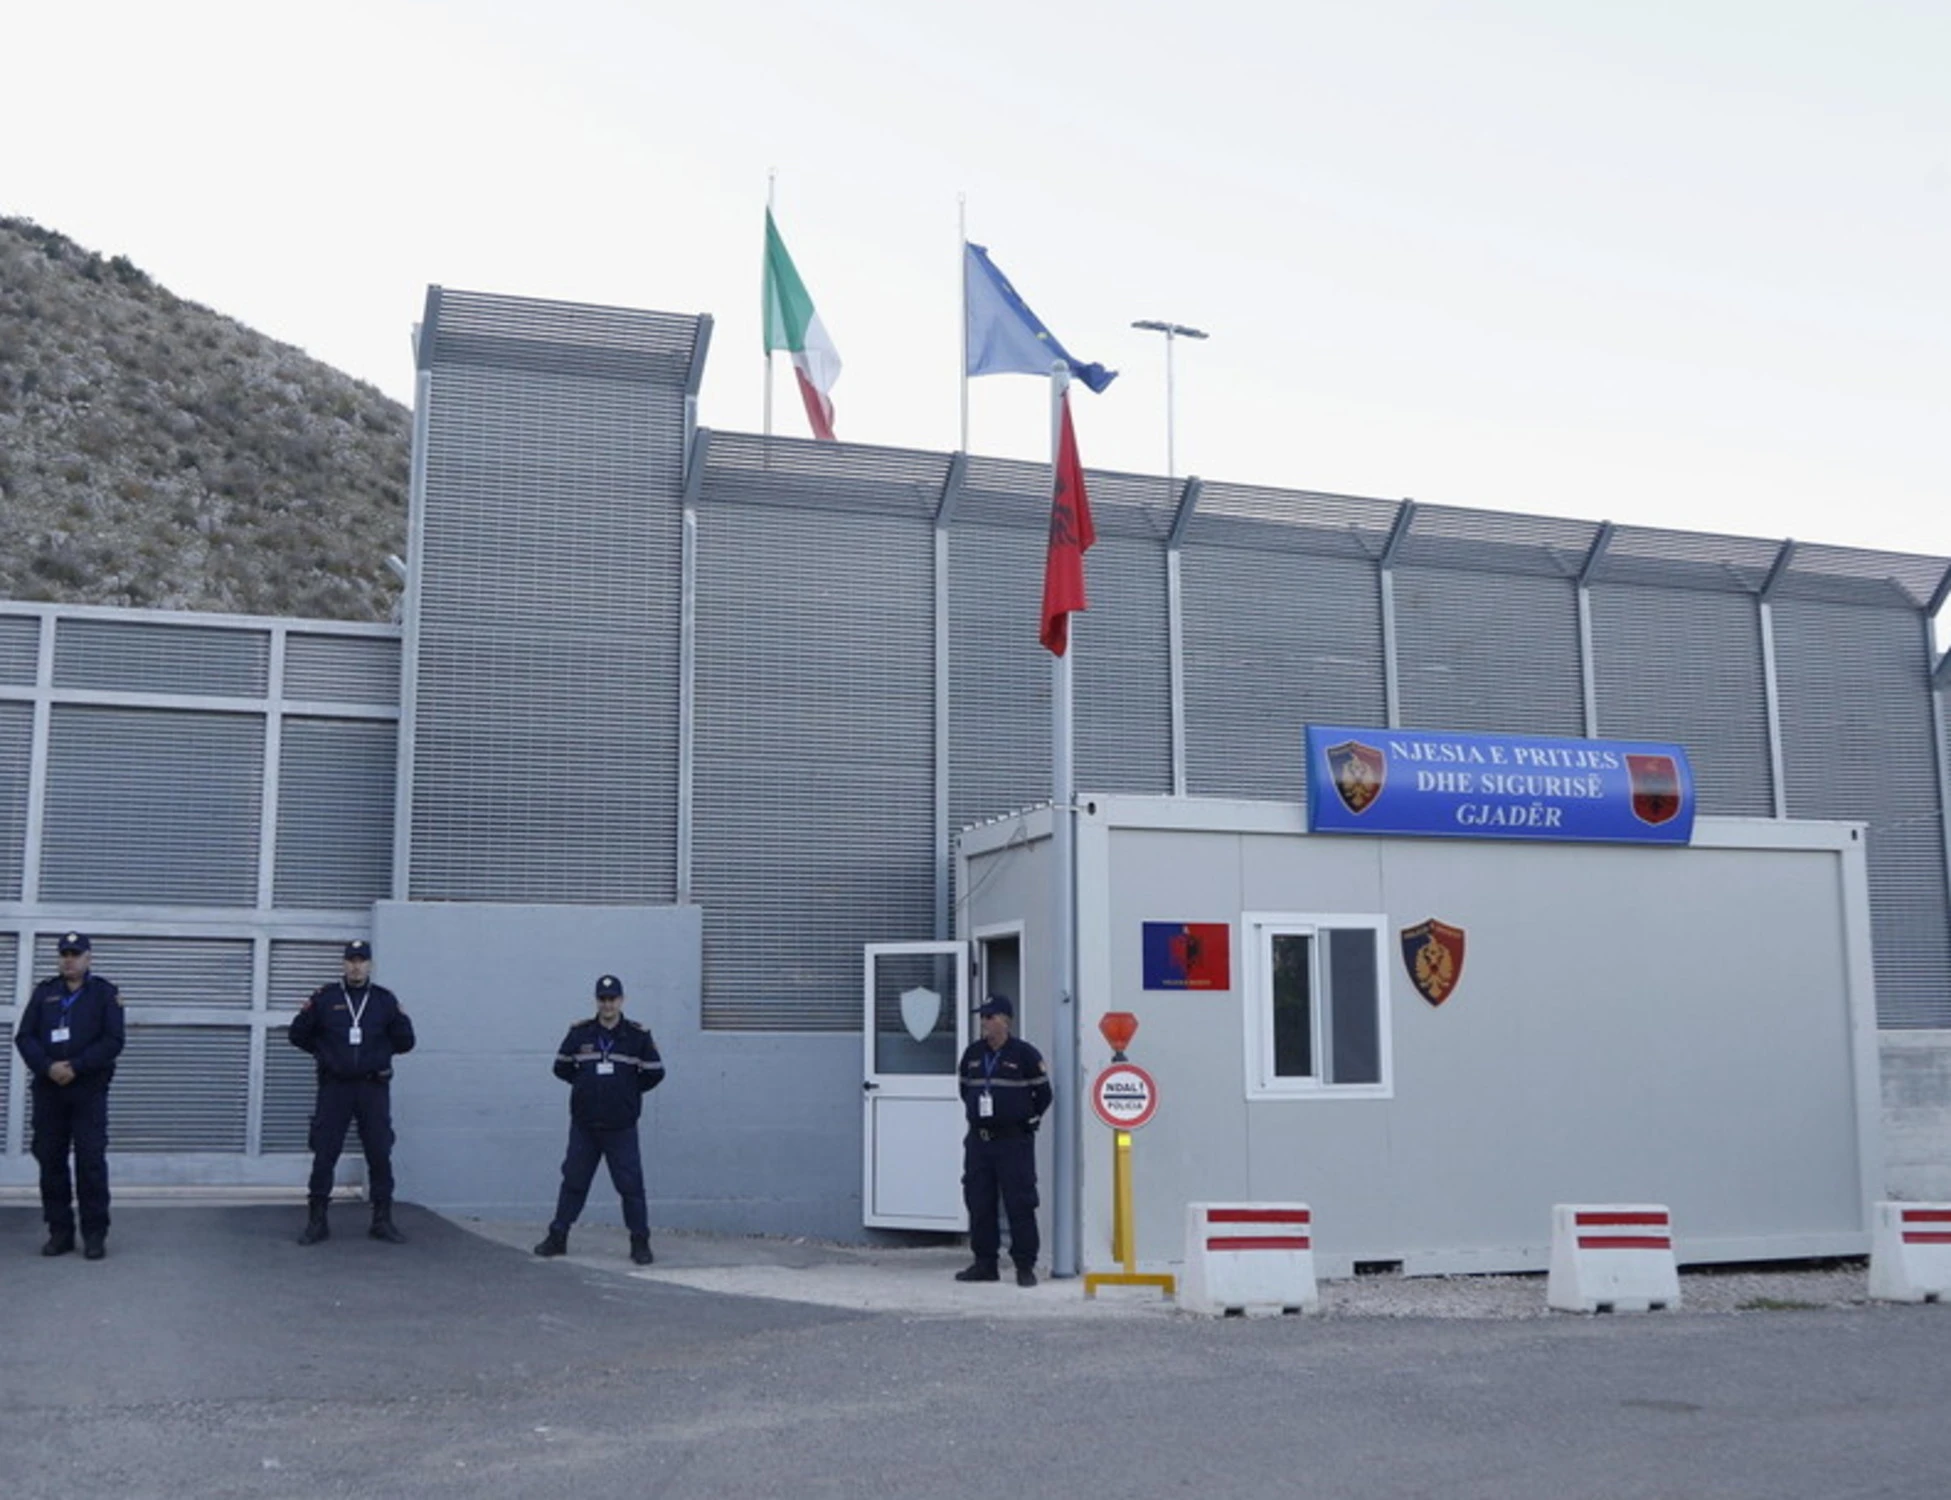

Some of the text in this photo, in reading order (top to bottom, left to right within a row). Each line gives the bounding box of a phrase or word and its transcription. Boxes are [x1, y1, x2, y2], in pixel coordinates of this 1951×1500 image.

[1389, 741, 1484, 764] NJESIA
[1489, 745, 1508, 764] E
[1514, 747, 1620, 769] PRITJES
[1417, 771, 1604, 799] DHE SIGURISË
[1456, 802, 1562, 827] GJADËR
